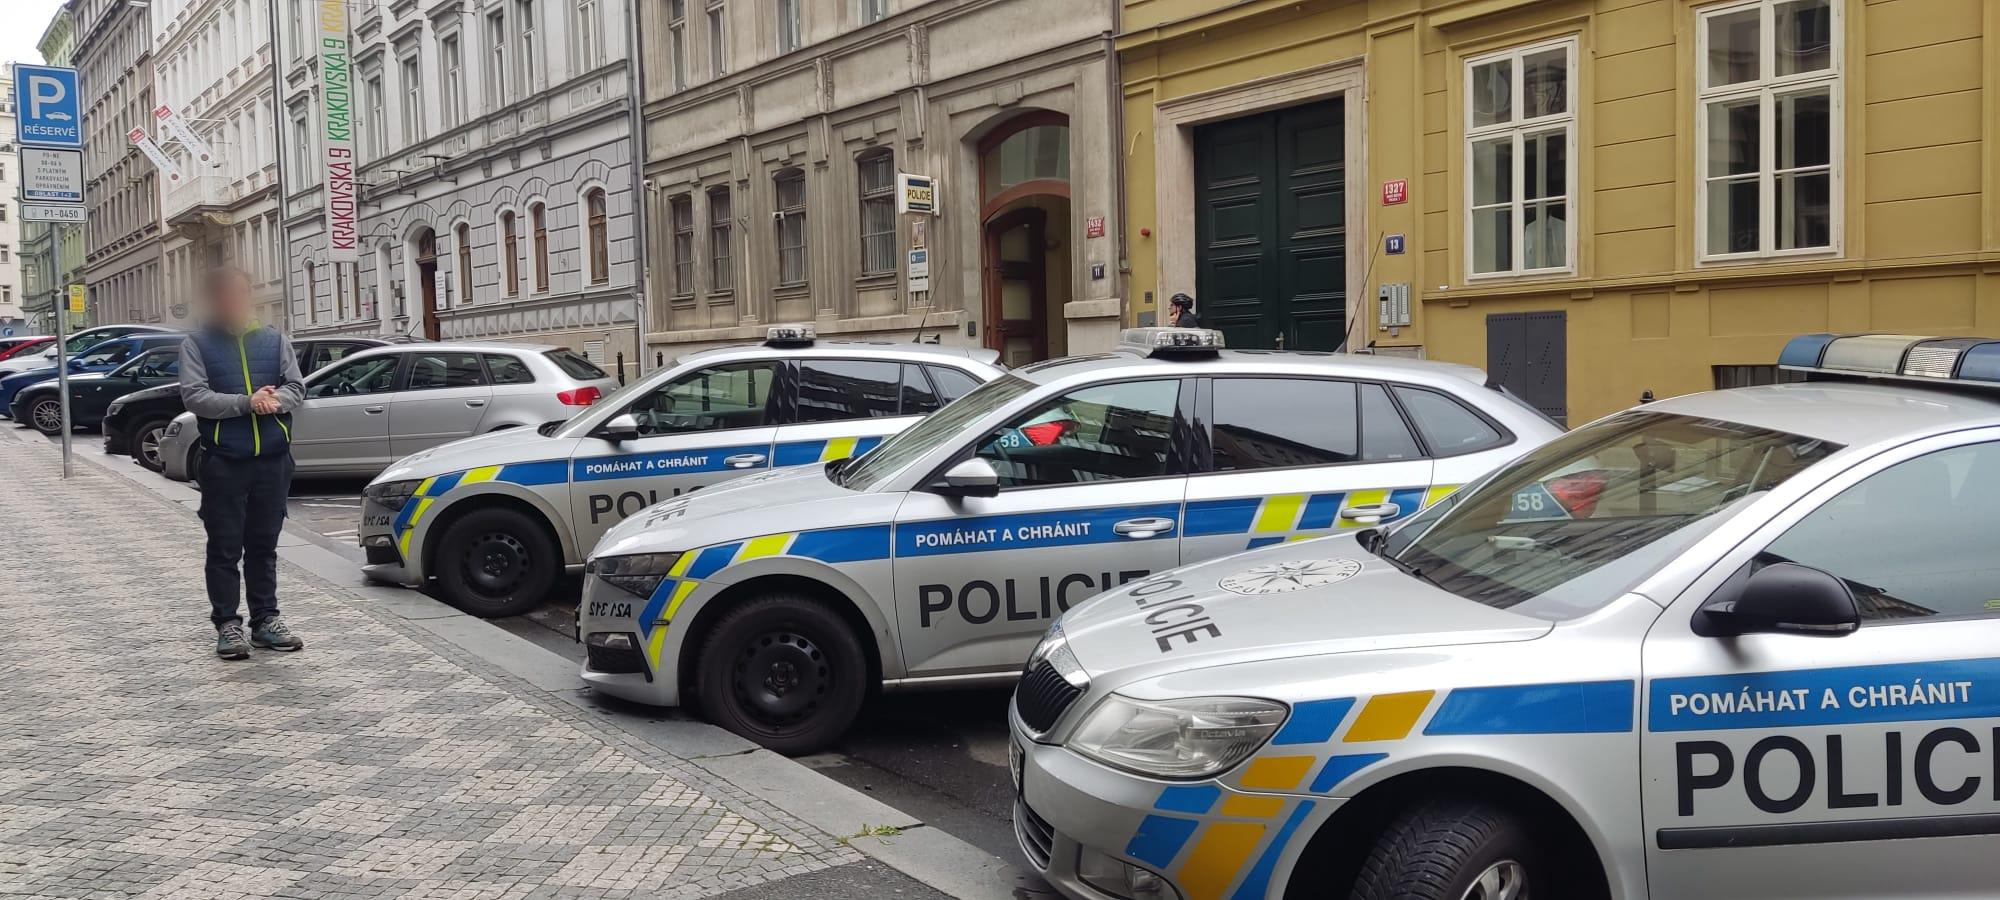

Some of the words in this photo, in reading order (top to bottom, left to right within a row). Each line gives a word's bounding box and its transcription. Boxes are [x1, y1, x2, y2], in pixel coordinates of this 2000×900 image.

[323, 38, 346, 49] 9
[29, 75, 65, 119] P
[322, 53, 350, 141] KRAKOVSKÁ
[24, 123, 76, 137] RÉSERVÉ
[329, 148, 352, 158] 9
[907, 189, 931, 200] POLICIE
[1385, 182, 1404, 195] 1327
[44, 209, 79, 218] P1-0450
[327, 162, 355, 249] KRAKOVSKÁ
[1389, 239, 1399, 250] 13
[996, 434, 1020, 448] 58
[586, 461, 642, 474] POMÁHAT
[646, 461, 655, 470] A
[657, 456, 709, 469] CHRÁNIT
[1511, 492, 1544, 512] 58
[915, 528, 997, 547] POMÁHAT
[1002, 527, 1013, 541] A
[1018, 521, 1091, 540] CHRÁNIT
[1670, 686, 1809, 716] POMÁHAT
[1821, 688, 1840, 709] A
[1848, 678, 1972, 708] CHRÁNIT
[1676, 727, 2000, 816] POLIC
